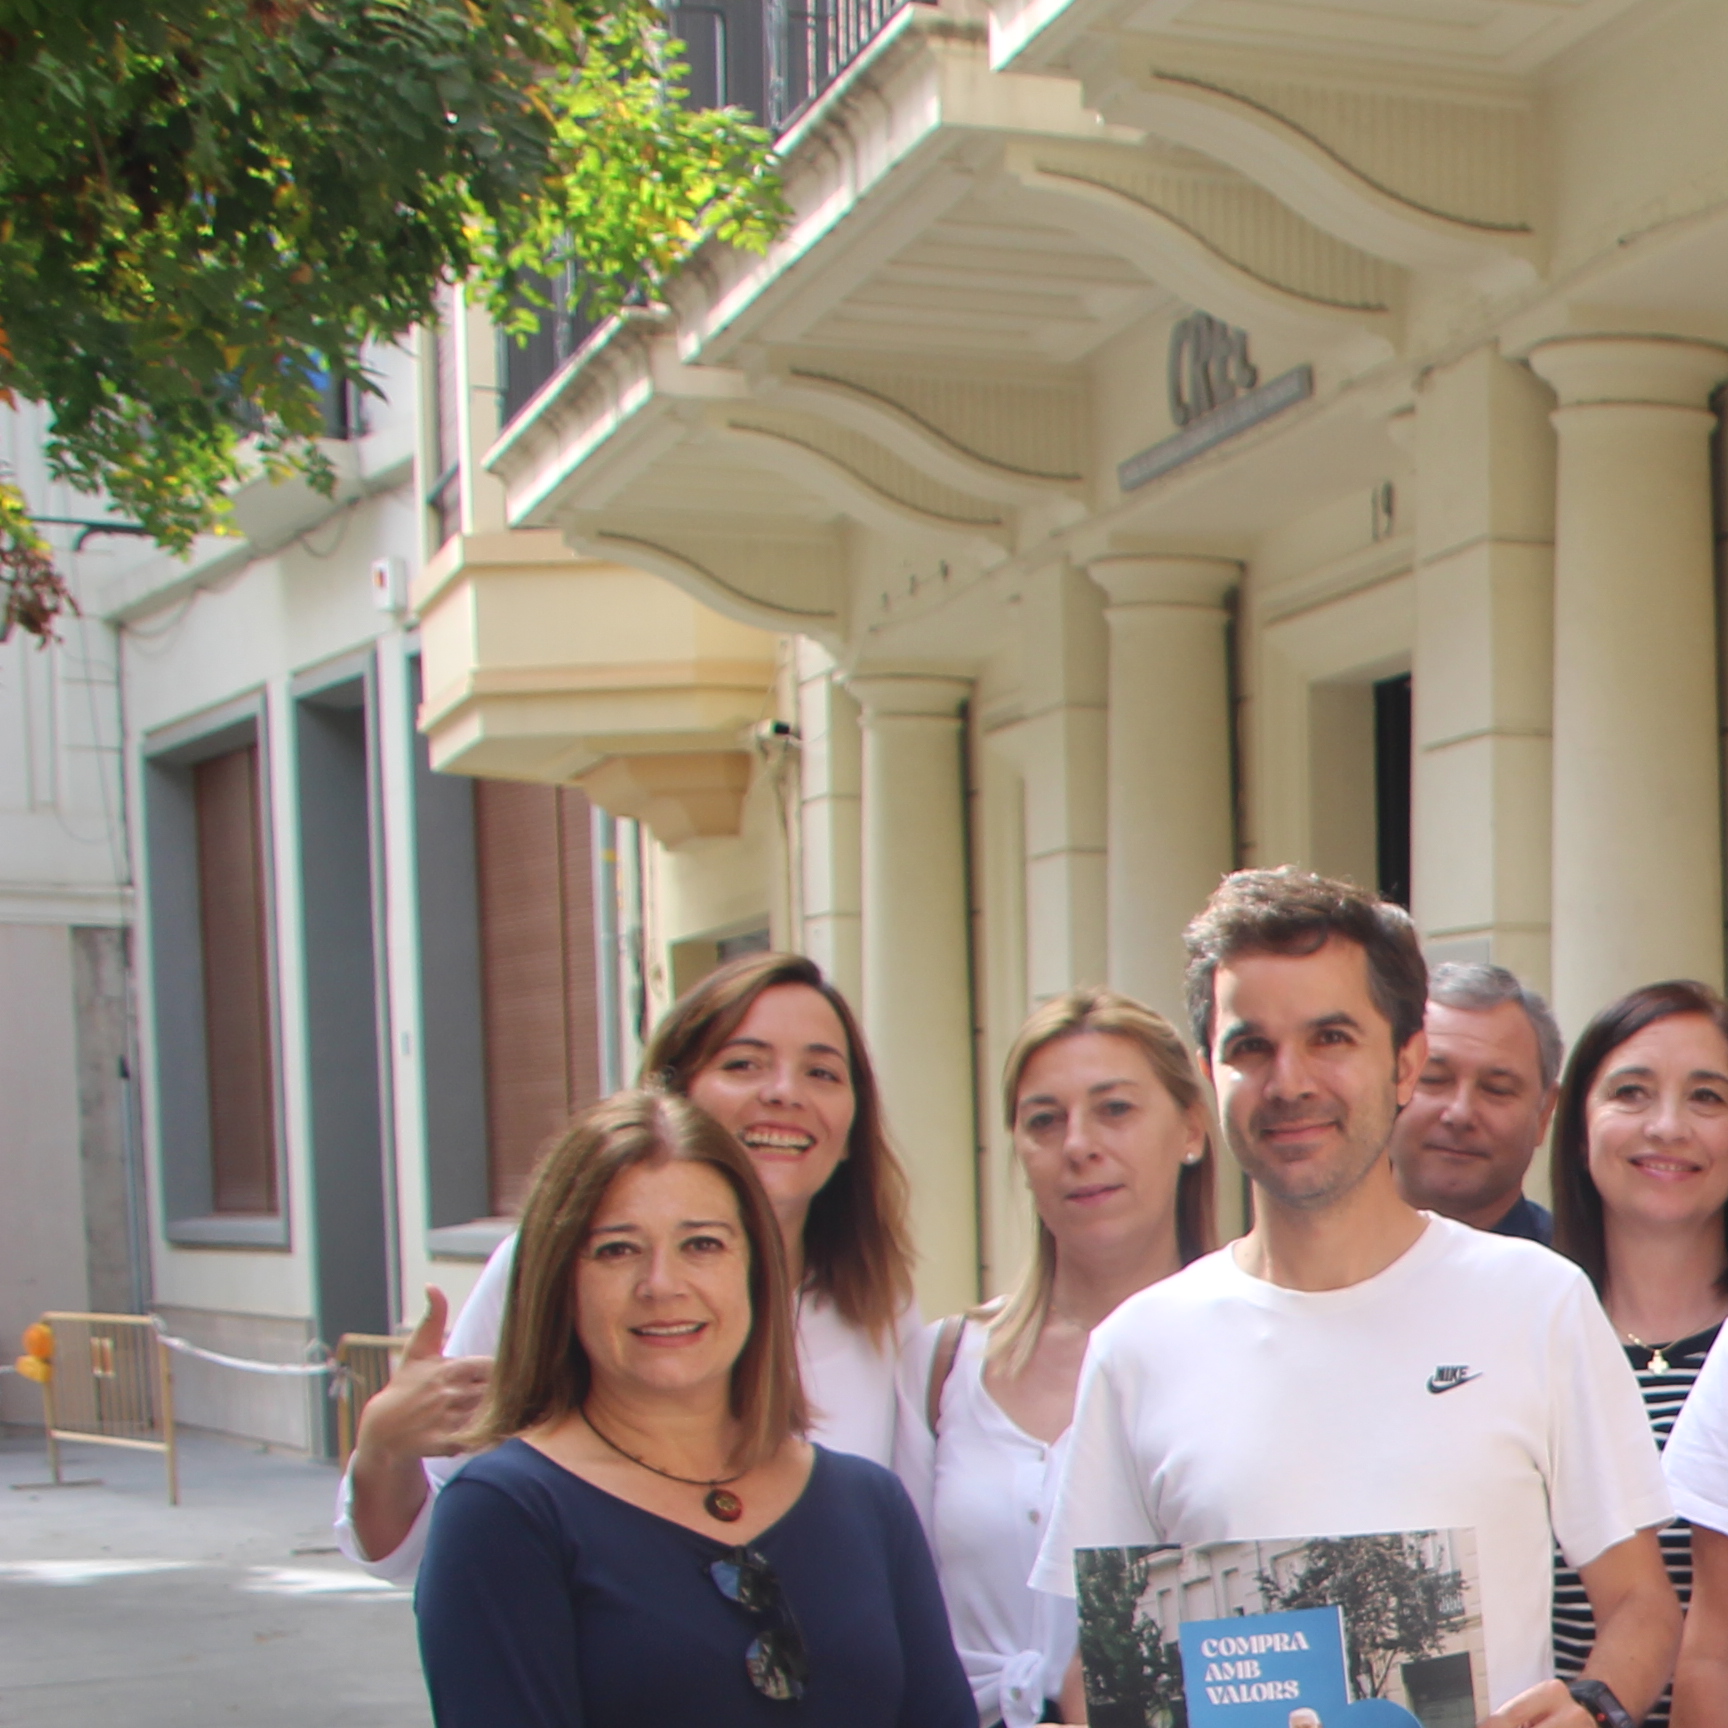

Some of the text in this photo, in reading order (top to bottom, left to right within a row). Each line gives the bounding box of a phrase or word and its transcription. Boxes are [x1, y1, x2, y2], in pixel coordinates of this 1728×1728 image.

[1434, 1364, 1469, 1382] NIKE
[1201, 1631, 1309, 1658] COMPRA
[1205, 1659, 1261, 1682] AMB
[1205, 1680, 1300, 1705] VALORS
